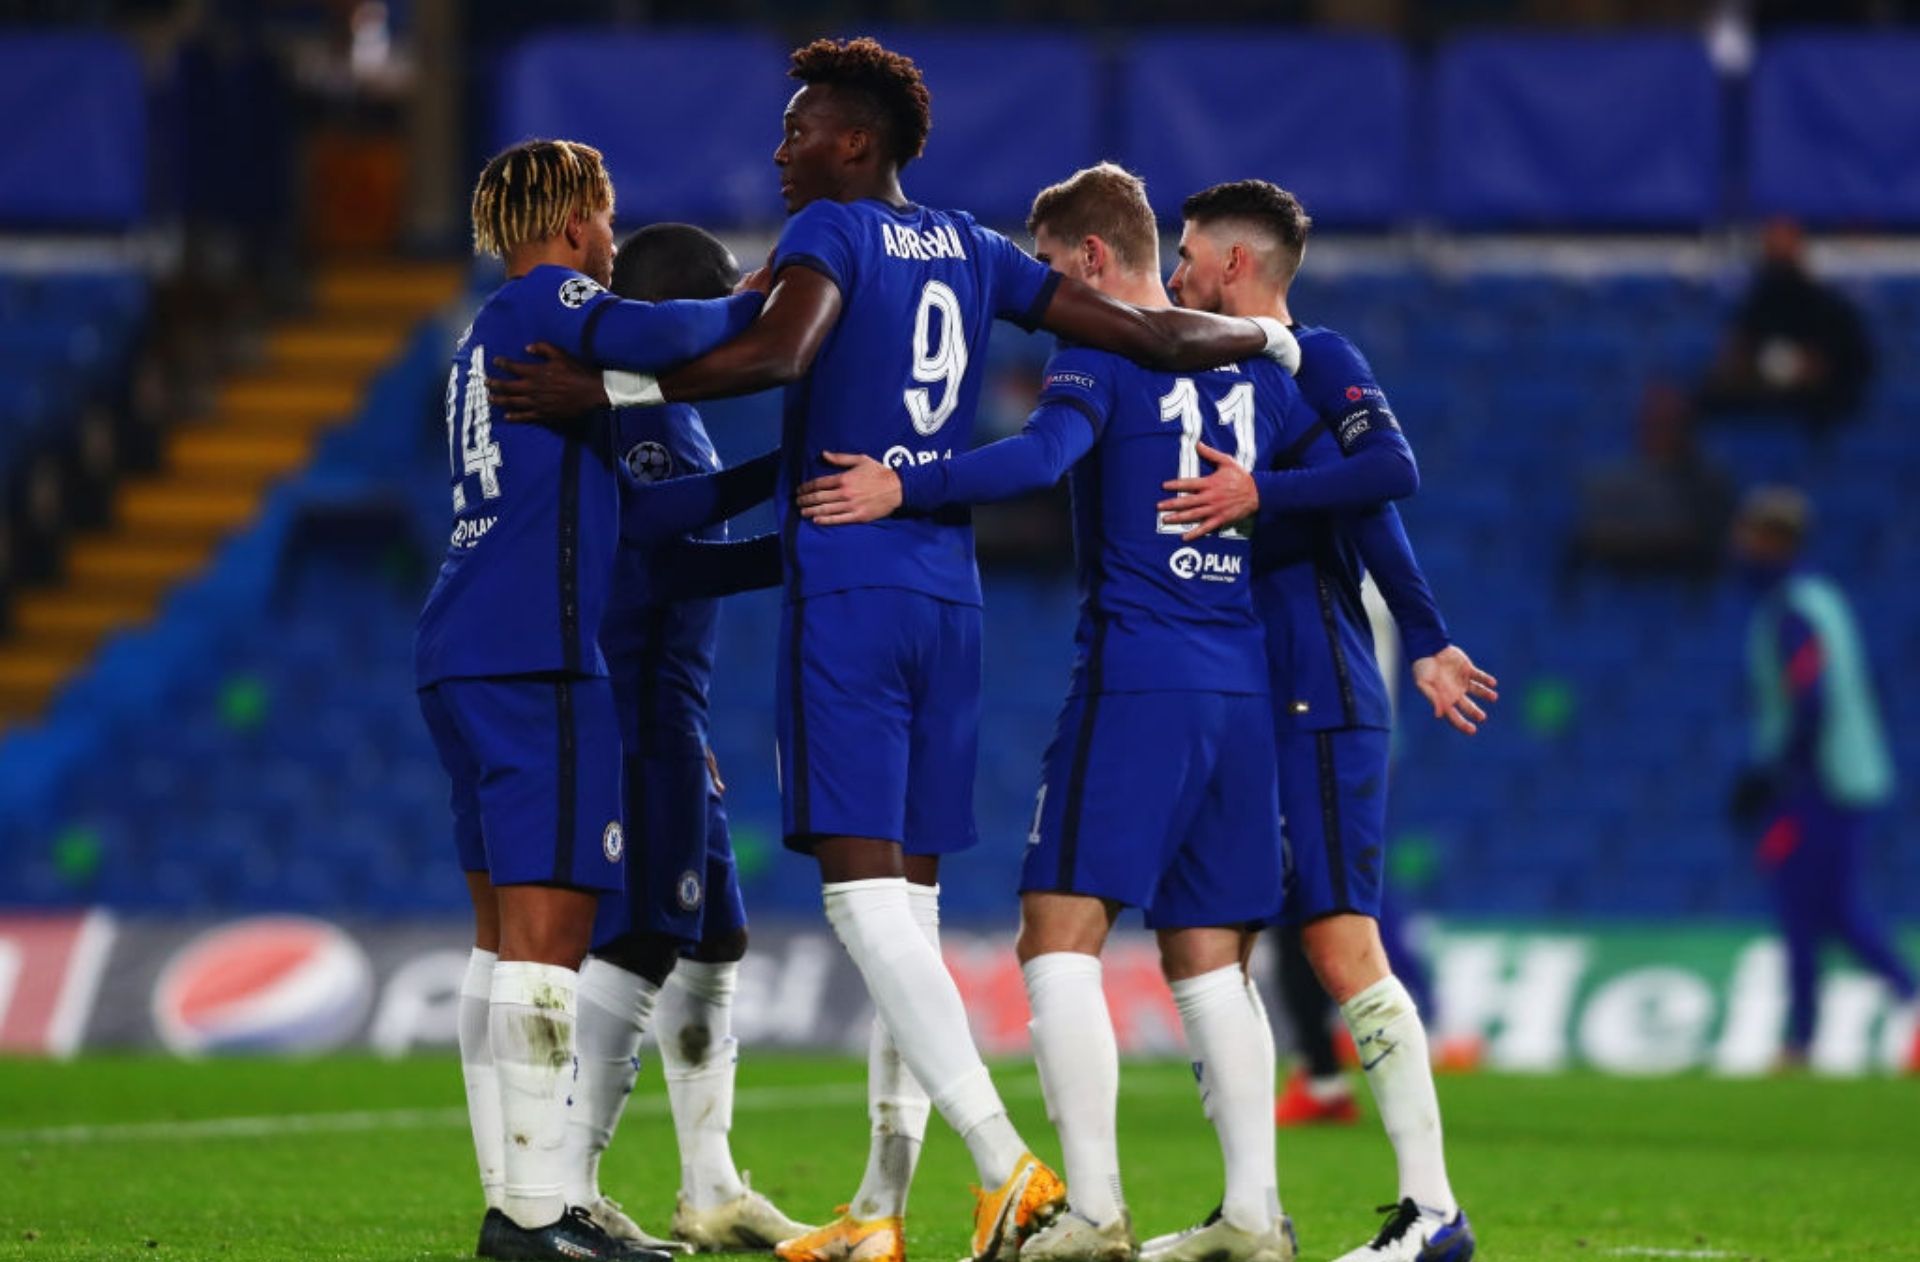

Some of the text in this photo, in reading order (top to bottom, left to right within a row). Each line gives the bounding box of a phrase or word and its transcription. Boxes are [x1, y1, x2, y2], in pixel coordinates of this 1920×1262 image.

[904, 279, 968, 436] 9
[1156, 377, 1257, 541] 11
[1203, 553, 1242, 574] PLAN
